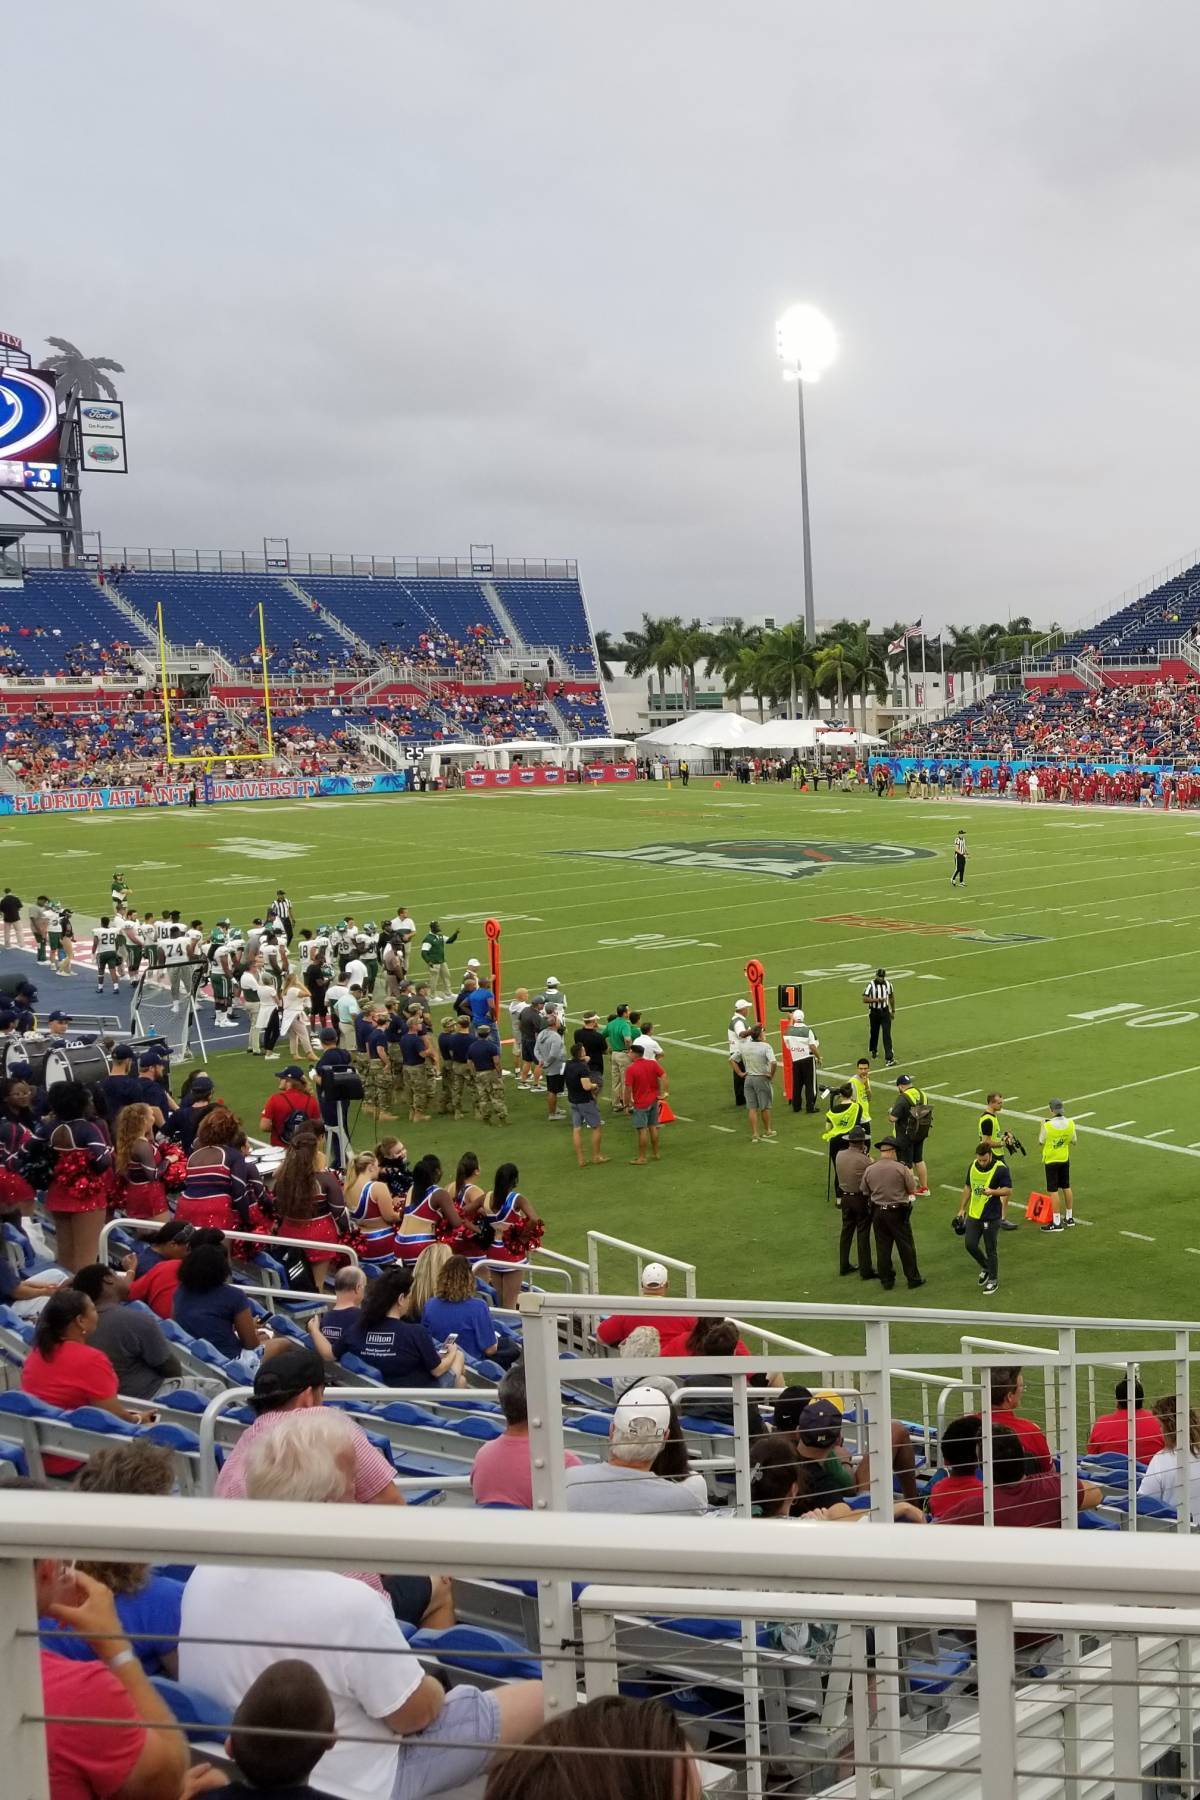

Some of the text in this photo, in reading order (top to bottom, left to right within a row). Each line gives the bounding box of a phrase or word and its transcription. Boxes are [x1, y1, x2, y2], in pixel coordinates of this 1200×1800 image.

[88, 408, 113, 420] Ford
[406, 747, 424, 760] 25
[14, 791, 103, 812] FLORIDA
[211, 780, 321, 801] UNIVERSITY
[101, 933, 115, 945] 28
[166, 944, 183, 957] 74
[786, 986, 795, 1007] 1
[1067, 1002, 1200, 1028] 10
[1033, 1195, 1045, 1217] G
[368, 1334, 392, 1343] Hilton
